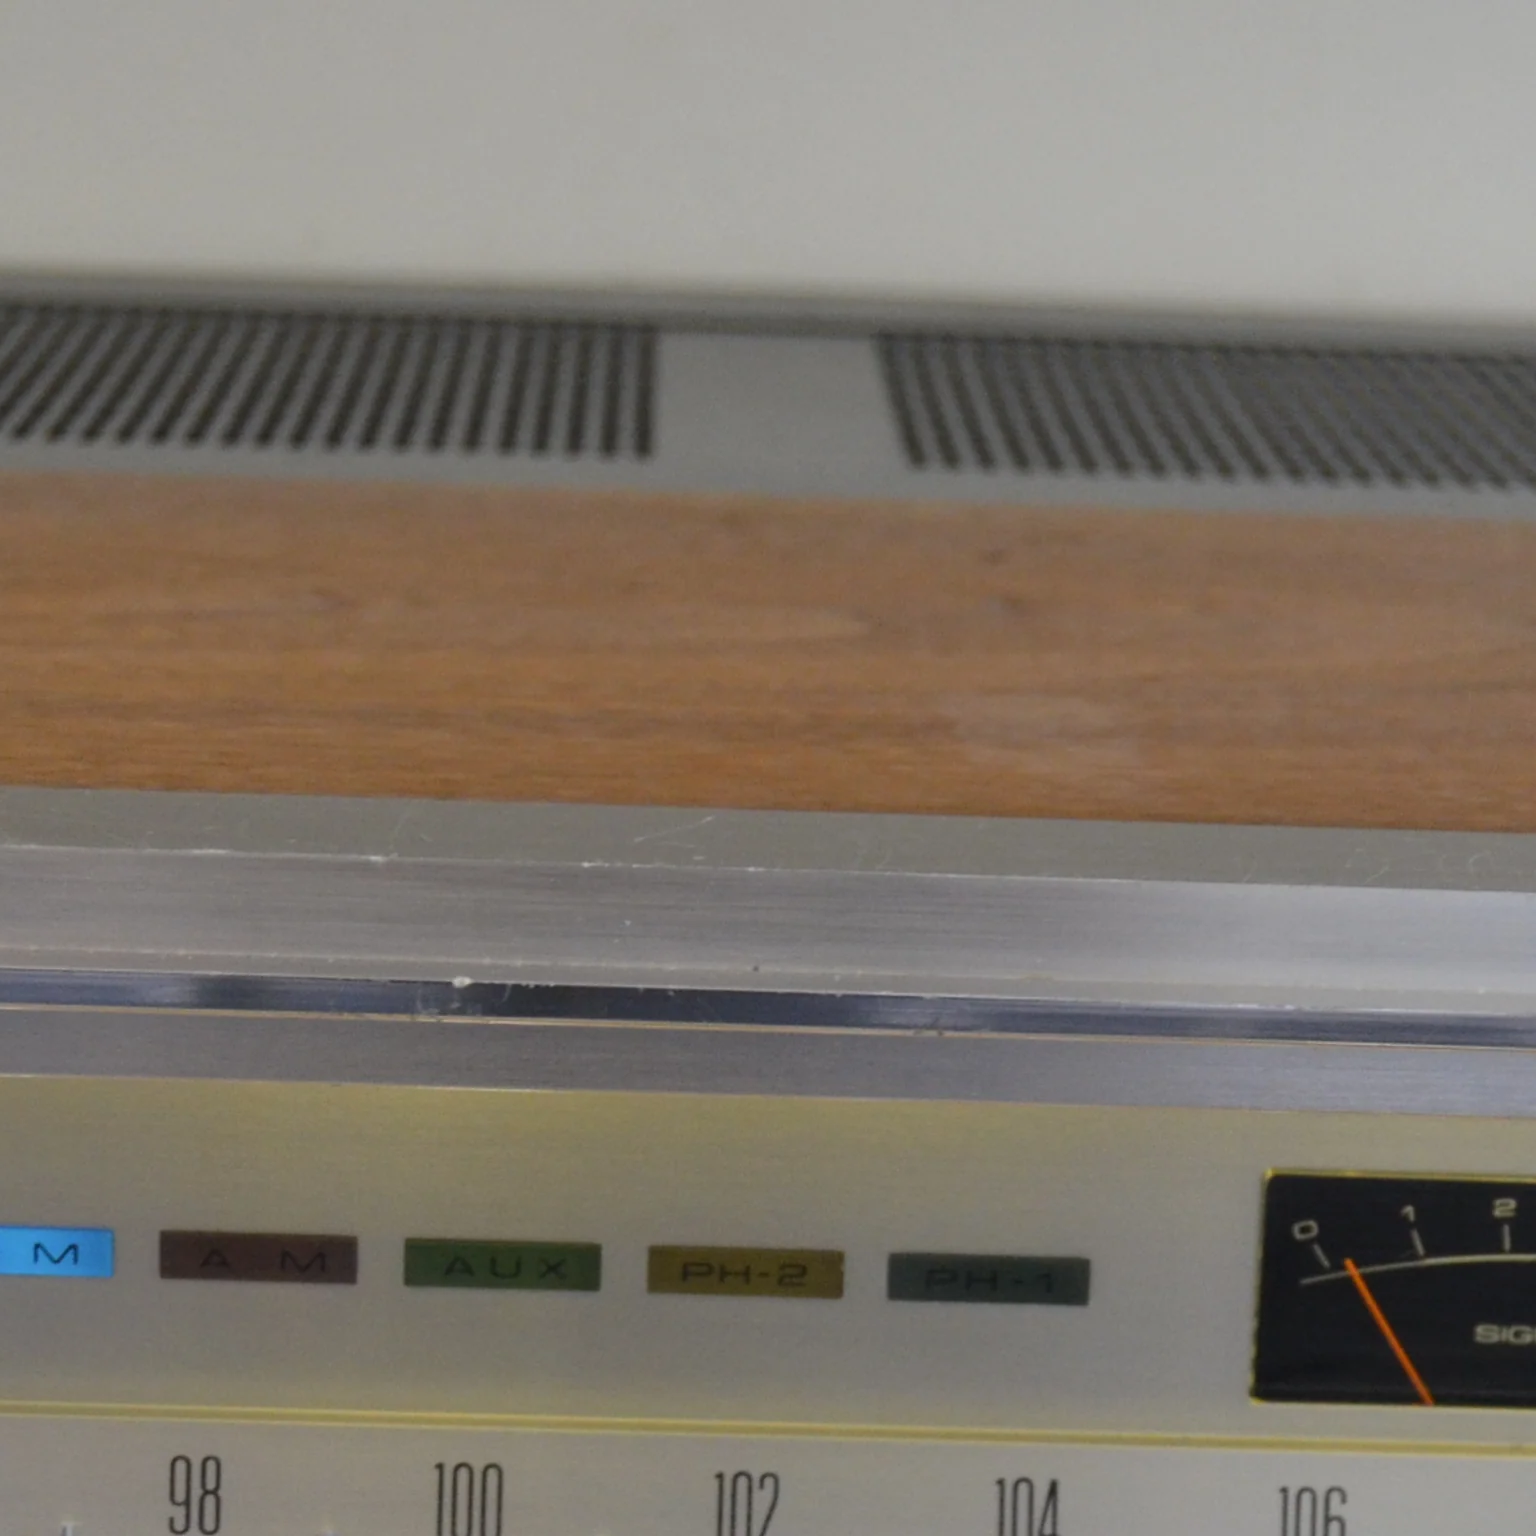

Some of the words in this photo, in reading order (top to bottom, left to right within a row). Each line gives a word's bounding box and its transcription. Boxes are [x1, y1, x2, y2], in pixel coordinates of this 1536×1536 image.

[1292, 1220, 1319, 1240] 0
[1400, 1205, 1416, 1223] 1
[1493, 1199, 1517, 1218] 2
[681, 1262, 808, 1288] PH-2
[925, 1267, 1055, 1294] PH-1
[168, 1456, 222, 1536] 98
